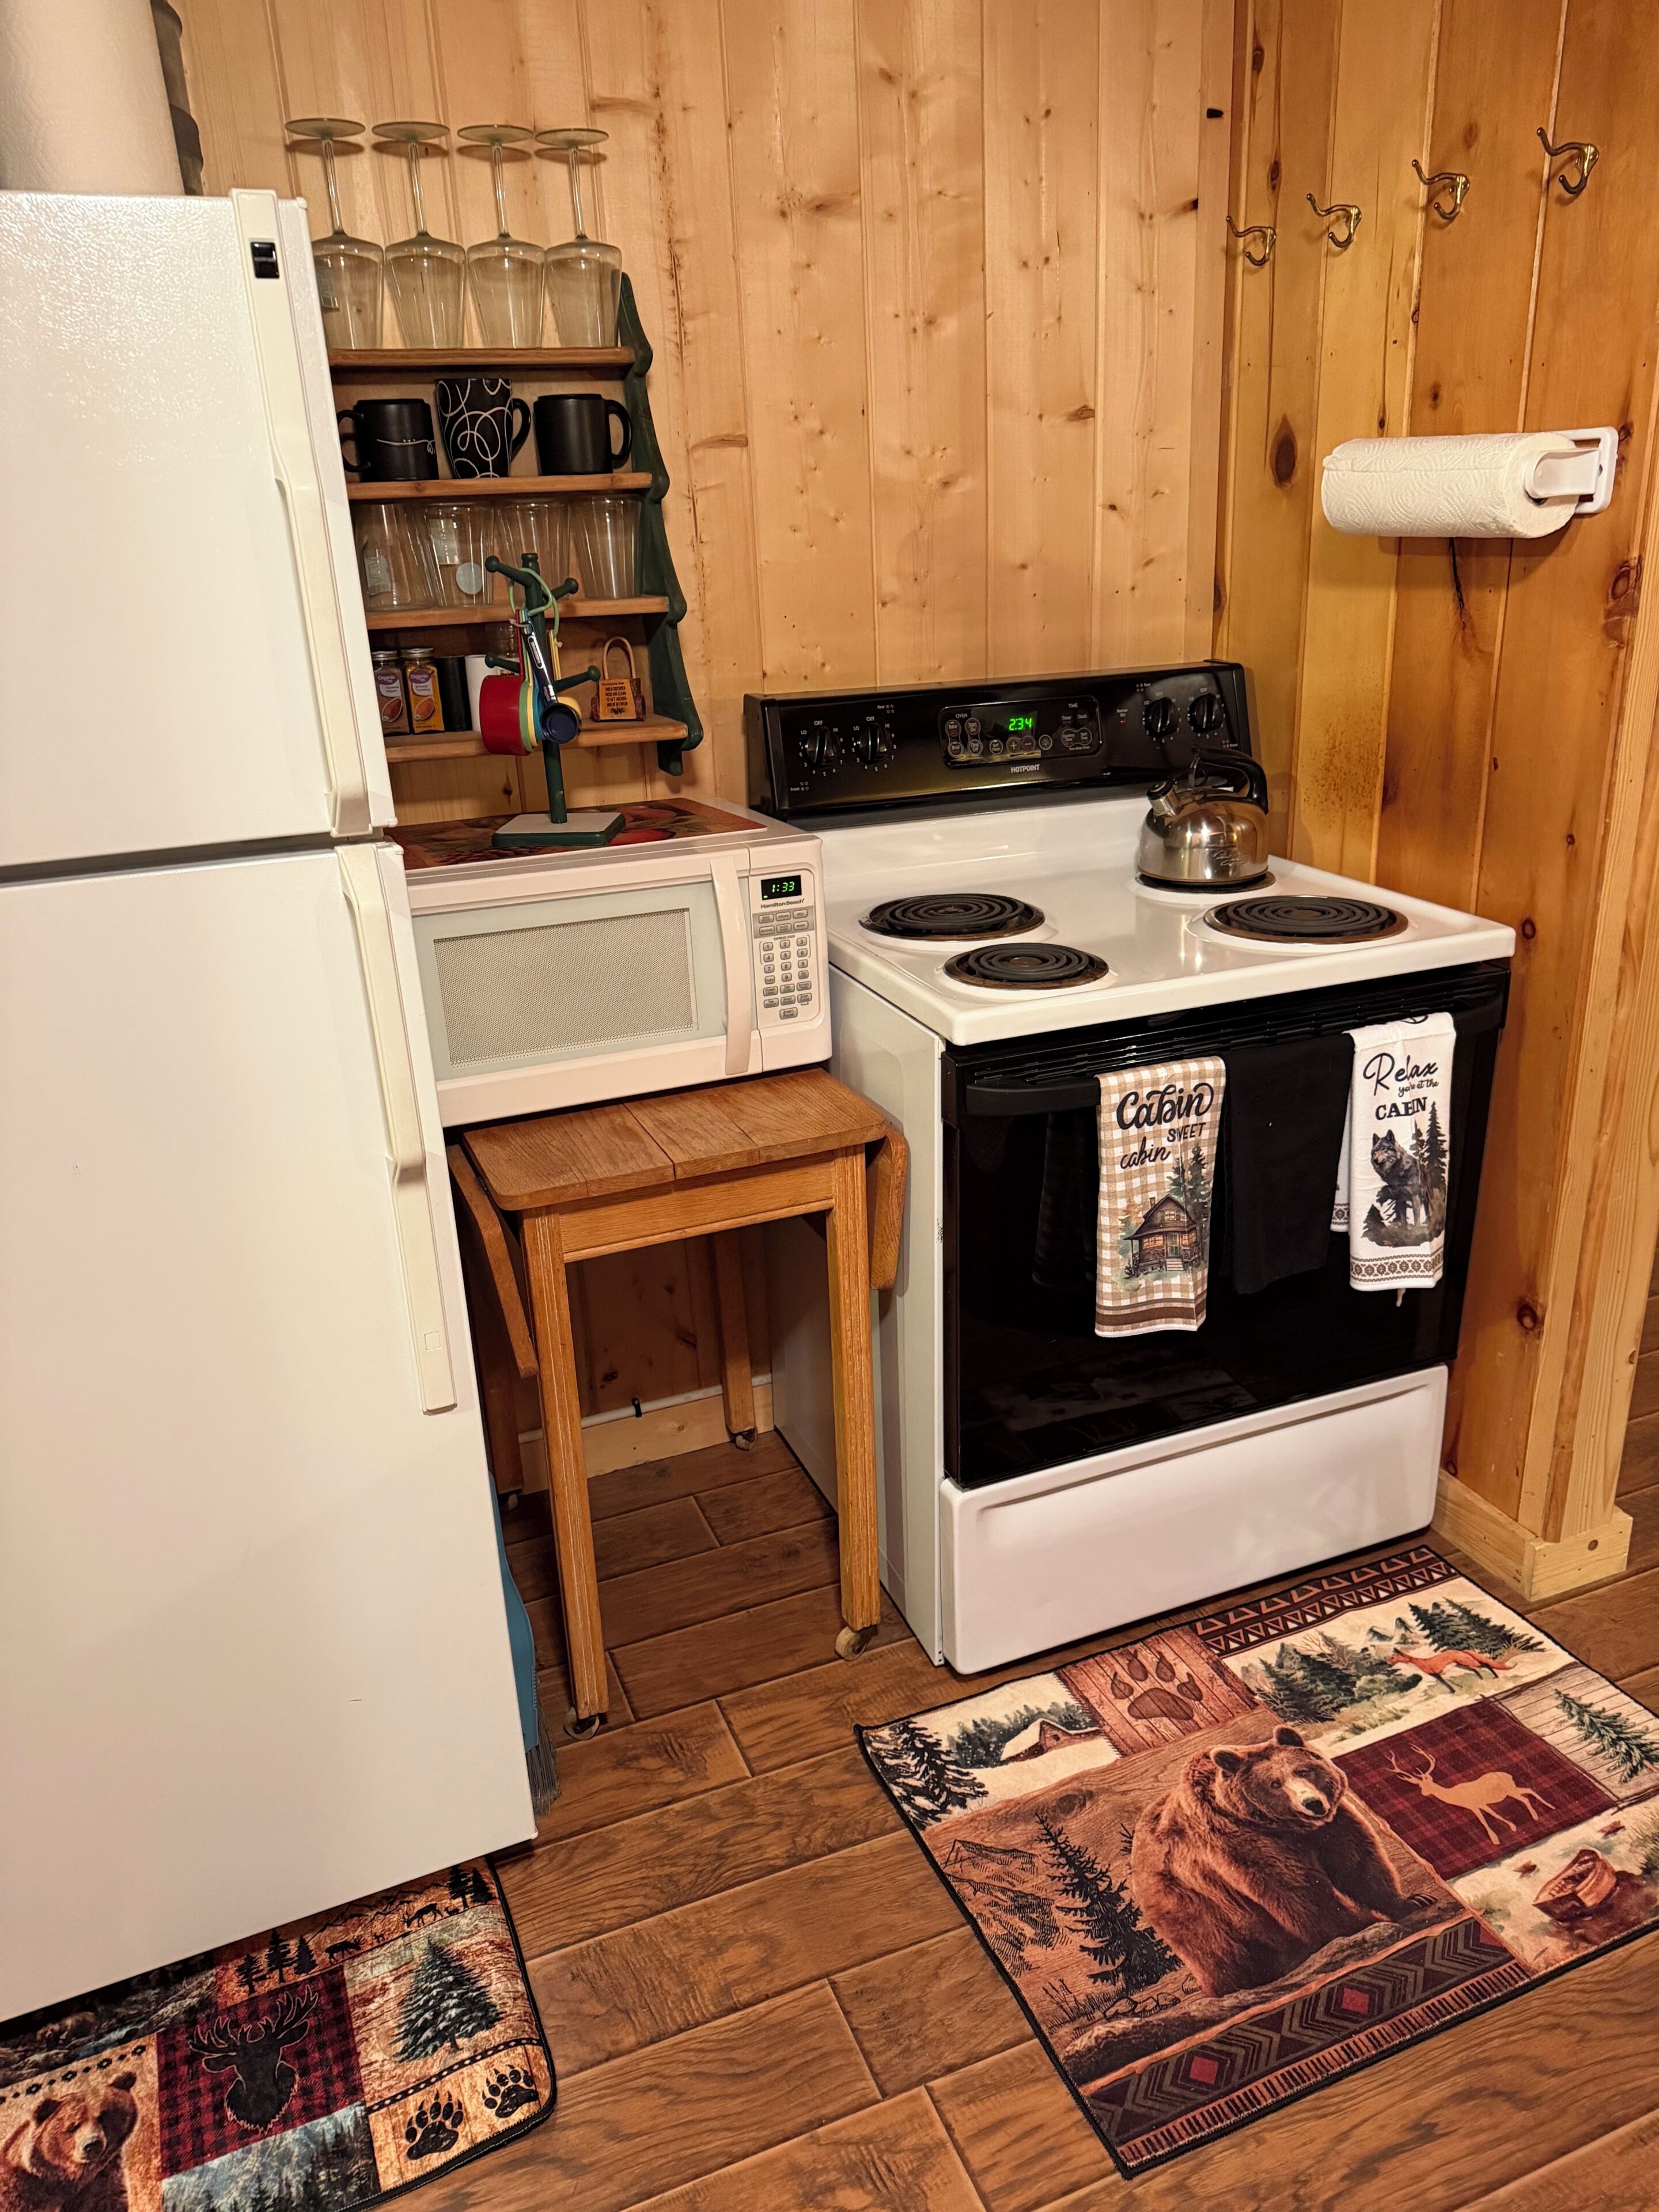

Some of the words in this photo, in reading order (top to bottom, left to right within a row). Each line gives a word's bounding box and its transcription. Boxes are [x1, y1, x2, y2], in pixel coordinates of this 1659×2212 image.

[1009, 718, 1032, 731] 2:34
[1011, 764, 1040, 773] HOTPOINT
[772, 881, 795, 893] 1:33
[1363, 1052, 1438, 1096] Relax
[1416, 1080, 1425, 1089] at
[1426, 1078, 1439, 1088] the
[1116, 1082, 1214, 1130] Cabin
[1375, 1097, 1427, 1120] CABIN
[1167, 1122, 1206, 1142] SWEET
[1120, 1136, 1171, 1169] cabin
